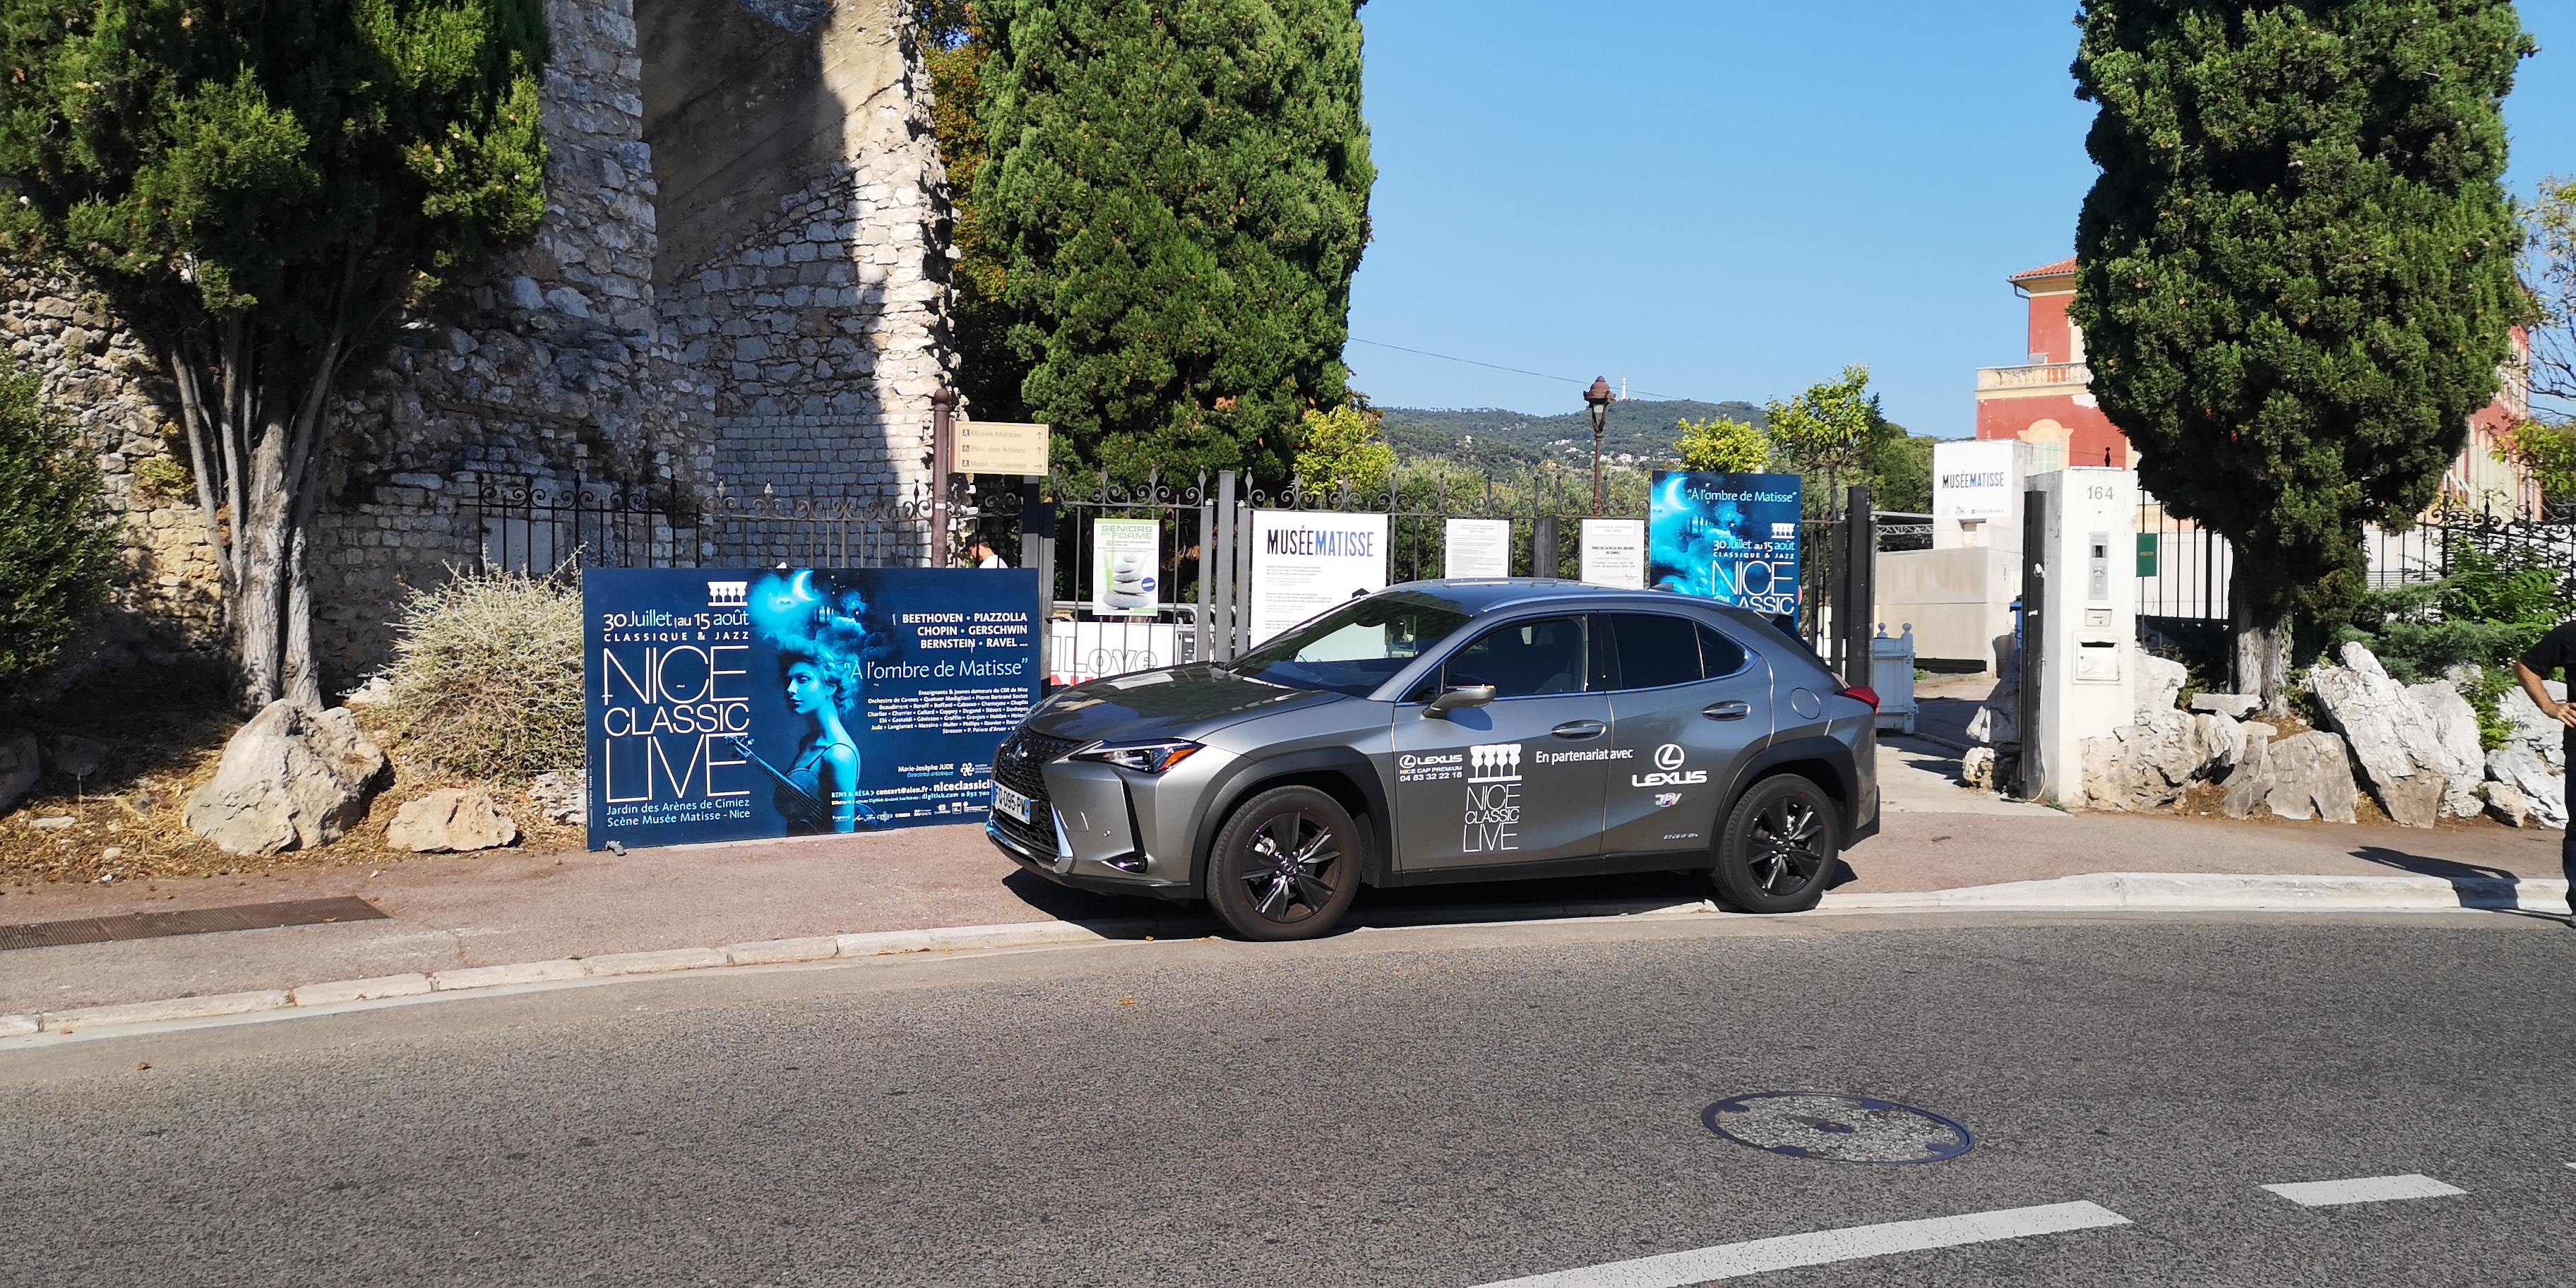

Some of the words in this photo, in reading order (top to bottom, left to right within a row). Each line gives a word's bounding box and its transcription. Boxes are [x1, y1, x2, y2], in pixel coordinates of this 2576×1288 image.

[1943, 471, 2004, 489] MUSÉEMATISSE
[1740, 491, 1753, 501] de
[2088, 486, 2113, 500] 164
[1268, 525, 1374, 557] MUSÉEMATISSE
[1713, 540, 1727, 551] 30
[1727, 539, 1752, 549] Juillet
[1764, 542, 1773, 552] 15
[1774, 539, 1796, 551] août
[1712, 560, 1794, 597] NICE
[603, 613, 627, 631] 30
[628, 609, 673, 627] Juillet
[677, 616, 692, 627] au
[694, 613, 710, 630] 15
[713, 609, 750, 626] août
[902, 613, 963, 624] BEETHOVEN
[974, 612, 1027, 623] PIAZZOLLA
[604, 632, 688, 643] CLASSIQUE
[698, 631, 705, 640] &
[715, 631, 749, 640] JAZZ
[917, 626, 958, 636] CHOPIN
[968, 625, 1027, 636] GERSCHWIN
[920, 638, 976, 649] BERNSTEIN
[986, 638, 1018, 648] RAVEL
[604, 645, 749, 705] NICE
[934, 660, 955, 677] de
[604, 703, 750, 737] CLASSIC
[1417, 754, 1463, 765] LEXUS
[1536, 751, 1549, 763] En
[1551, 748, 1609, 765] partenariat
[1610, 749, 1634, 759] avec
[606, 732, 751, 804] LIVE
[1632, 770, 1707, 787] LEXUS
[1466, 783, 1522, 811] NICE
[1654, 792, 1683, 808] JPV
[607, 804, 638, 816] Jardin
[641, 803, 660, 813] des
[662, 801, 698, 812] Arènes
[700, 799, 712, 809] de
[715, 797, 750, 809] Cimiez
[607, 816, 639, 828] Scène
[643, 814, 677, 825] Musée
[681, 811, 721, 823] Matisse
[729, 809, 751, 819] Nice
[1465, 808, 1520, 825] CLASSIC
[1463, 821, 1519, 852] LIVE
